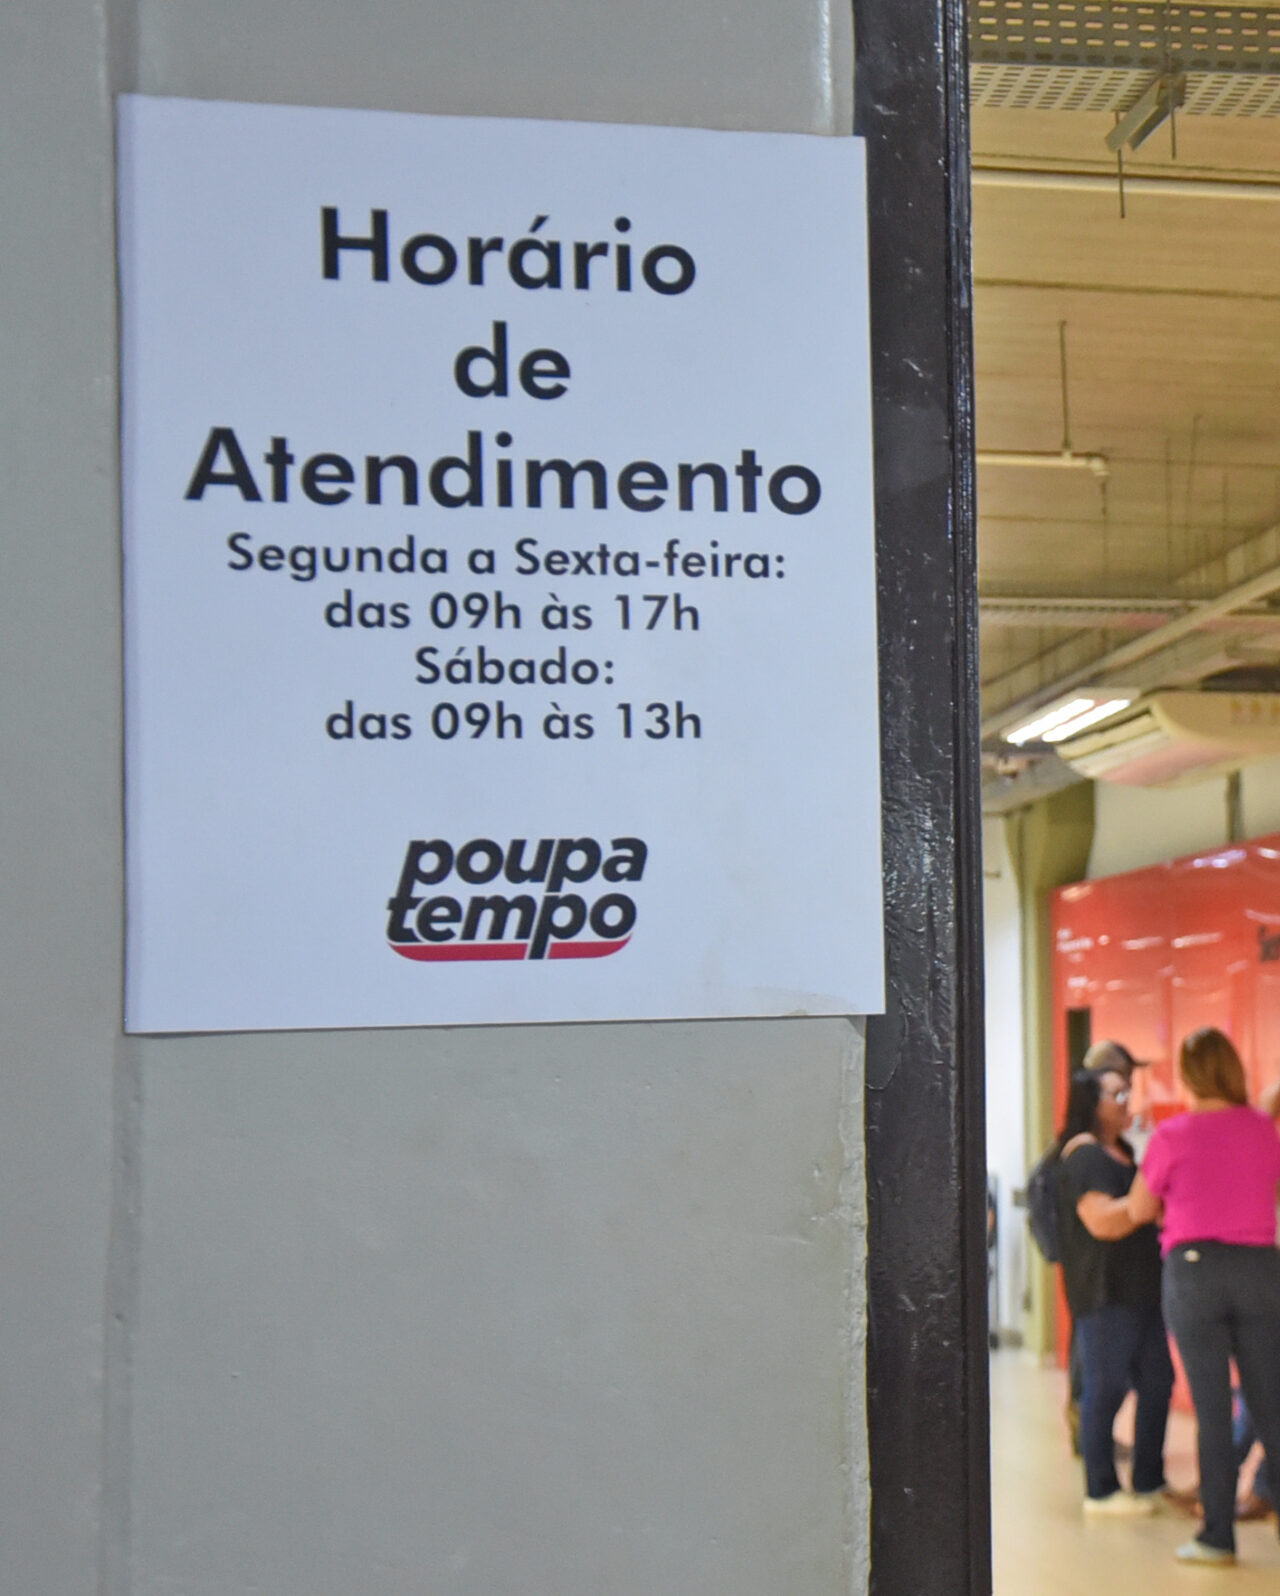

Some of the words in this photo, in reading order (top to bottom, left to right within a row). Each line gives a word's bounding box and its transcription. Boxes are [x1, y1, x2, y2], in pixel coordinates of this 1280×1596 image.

[321, 206, 697, 296] Horário
[454, 320, 571, 401] de
[184, 426, 822, 516] Atendimento
[227, 532, 448, 583] Segunda
[467, 548, 495, 575] a
[515, 537, 785, 579] Sexta-feira:
[324, 588, 411, 629] das
[430, 590, 521, 630] 09h
[541, 592, 593, 631] às
[615, 592, 699, 631] 17h
[415, 645, 614, 685] Sábado:
[326, 699, 412, 741] das
[431, 700, 523, 741] 09h
[543, 702, 595, 740] às
[617, 700, 701, 740] 13h
[396, 837, 648, 897] poupa
[386, 892, 637, 960] tempo
